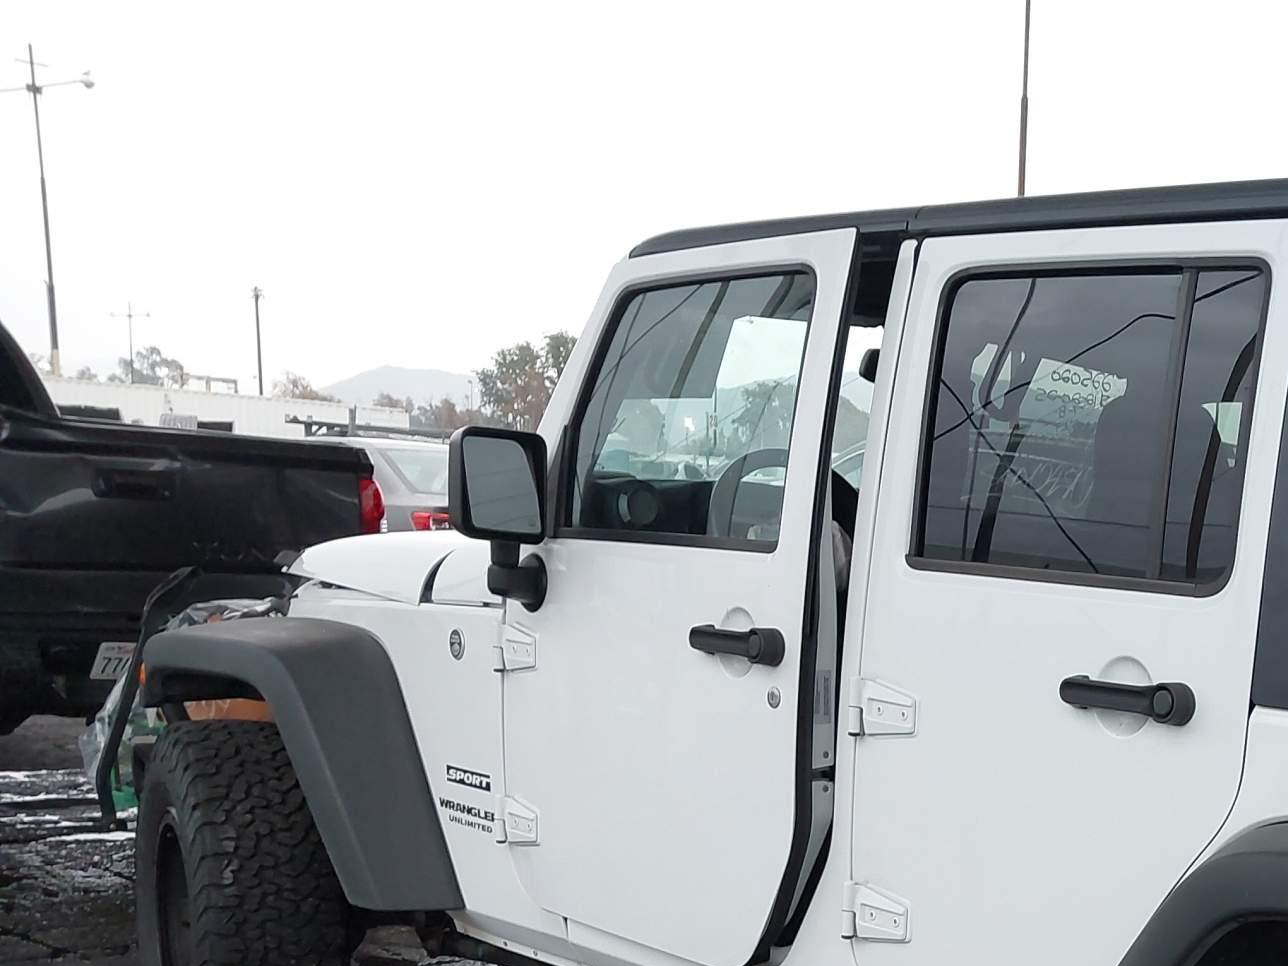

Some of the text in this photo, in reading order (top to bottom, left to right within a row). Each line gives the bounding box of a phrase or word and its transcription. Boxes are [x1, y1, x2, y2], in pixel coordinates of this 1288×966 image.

[101, 656, 131, 675] 77
[447, 766, 489, 790] SPORT
[448, 813, 493, 834] UNLIMITED
